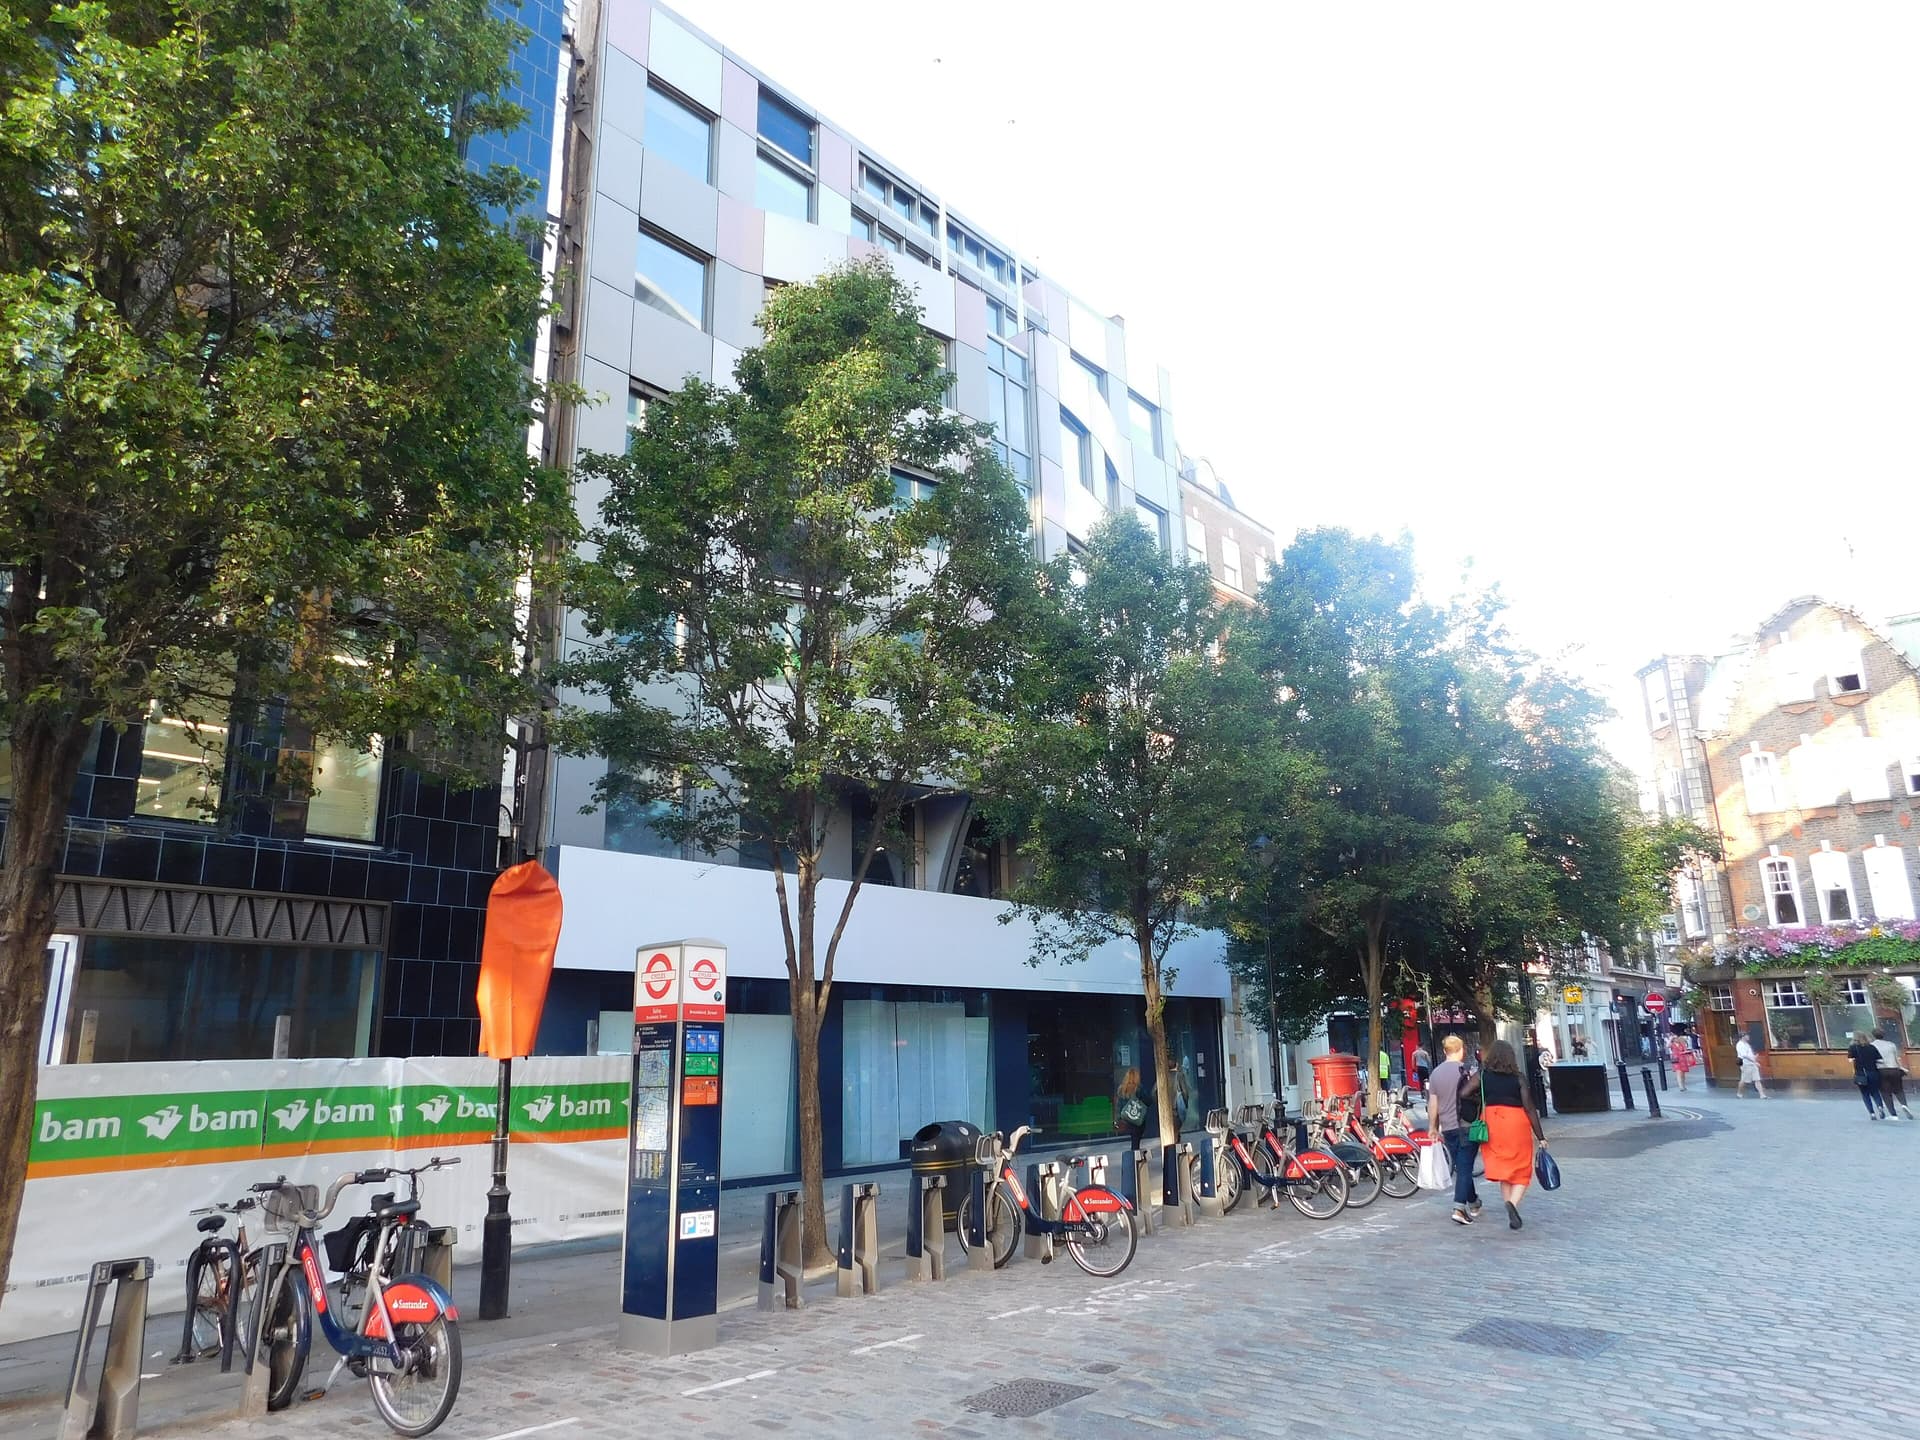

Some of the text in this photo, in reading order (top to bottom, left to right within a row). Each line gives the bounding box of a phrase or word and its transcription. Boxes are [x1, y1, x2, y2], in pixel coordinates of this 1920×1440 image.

[313, 1100, 375, 1125] bam
[560, 1094, 611, 1117] bam
[39, 1112, 121, 1143] bam
[189, 1104, 258, 1132] bam
[1089, 1197, 1113, 1205] Santander
[398, 1298, 429, 1310] Santander
